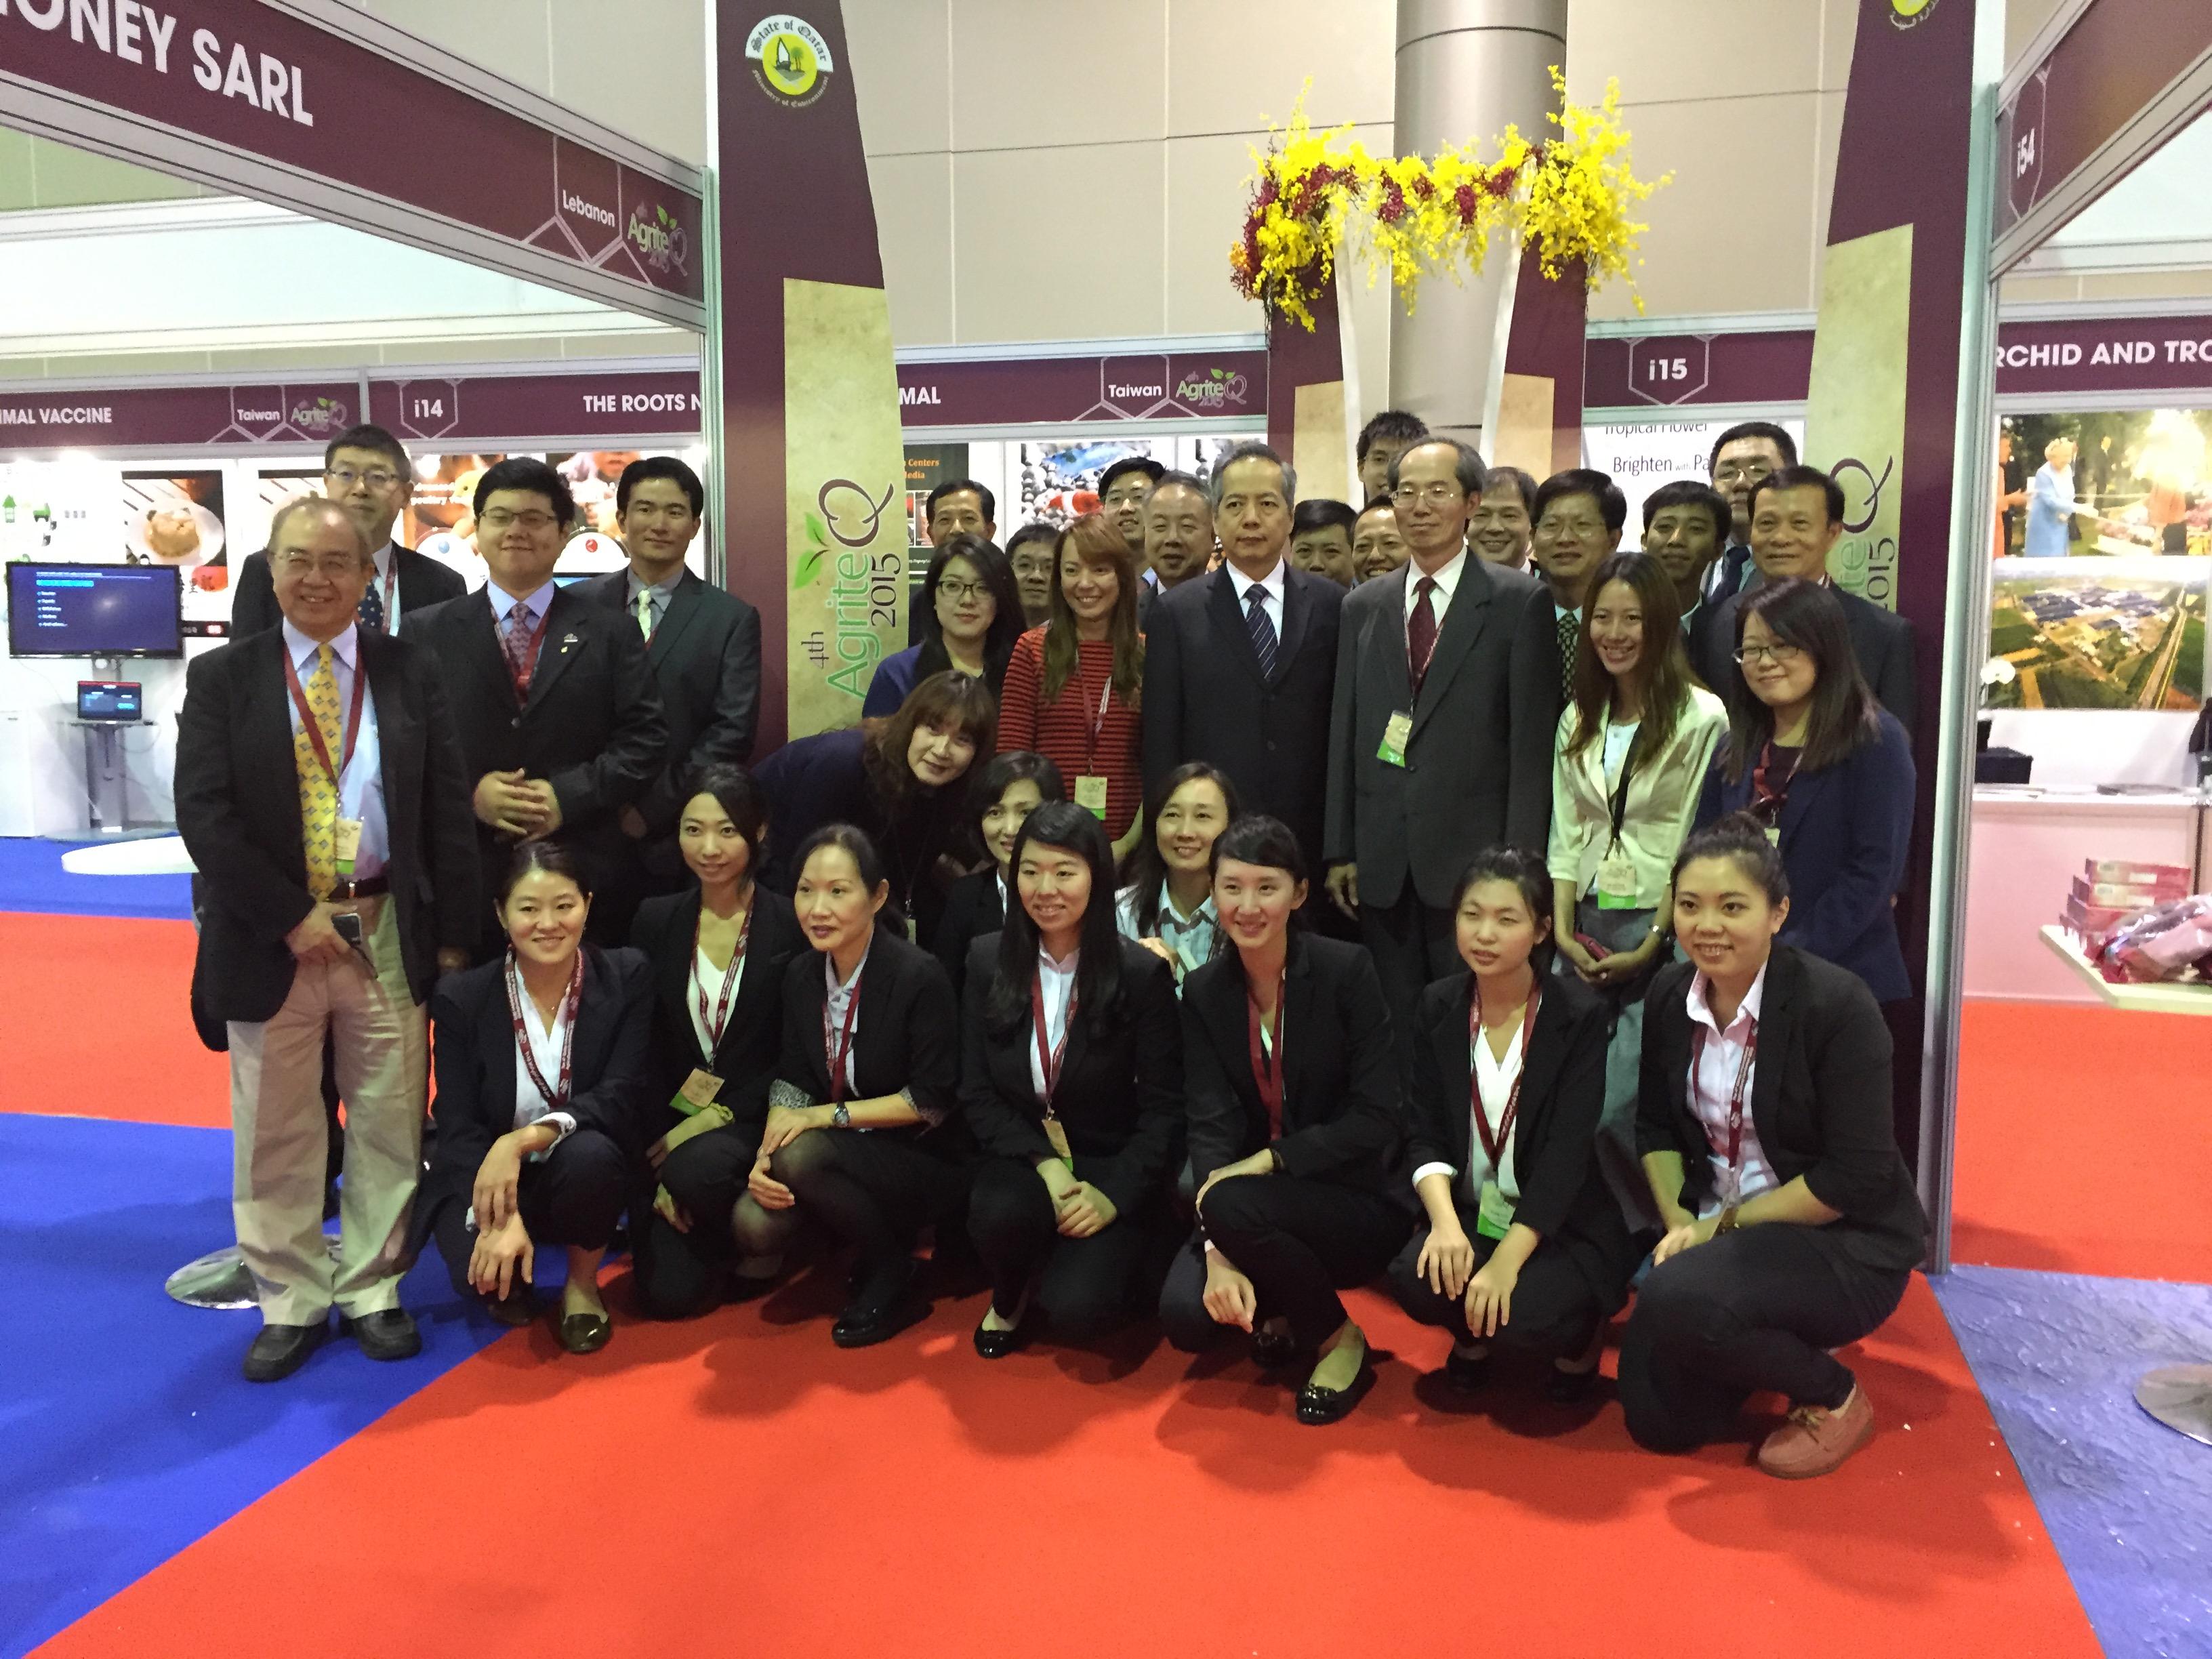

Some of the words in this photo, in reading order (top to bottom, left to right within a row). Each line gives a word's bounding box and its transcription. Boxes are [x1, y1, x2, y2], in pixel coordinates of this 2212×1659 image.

[751, 21, 780, 52] State
[784, 20, 794, 31] of
[798, 26, 827, 62] Qatar
[192, 28, 313, 127] SARL
[2017, 128, 2035, 179] i54
[562, 189, 615, 228] Lebanon
[2089, 341, 2156, 365] AND
[1649, 358, 1687, 381] i15
[899, 386, 941, 405] MAL
[1108, 383, 1162, 398] Taiwan
[414, 398, 443, 417] i14
[583, 395, 616, 412] THE
[621, 394, 686, 412] ROOTS
[39, 407, 112, 424] VACCINE
[237, 409, 281, 421] Taiwan
[908, 458, 940, 467] Centers
[1614, 455, 1673, 476] Brighten
[903, 470, 925, 479] edia
[1866, 537, 1896, 611] 015
[871, 552, 901, 628] 2015
[800, 630, 830, 670] 4th
